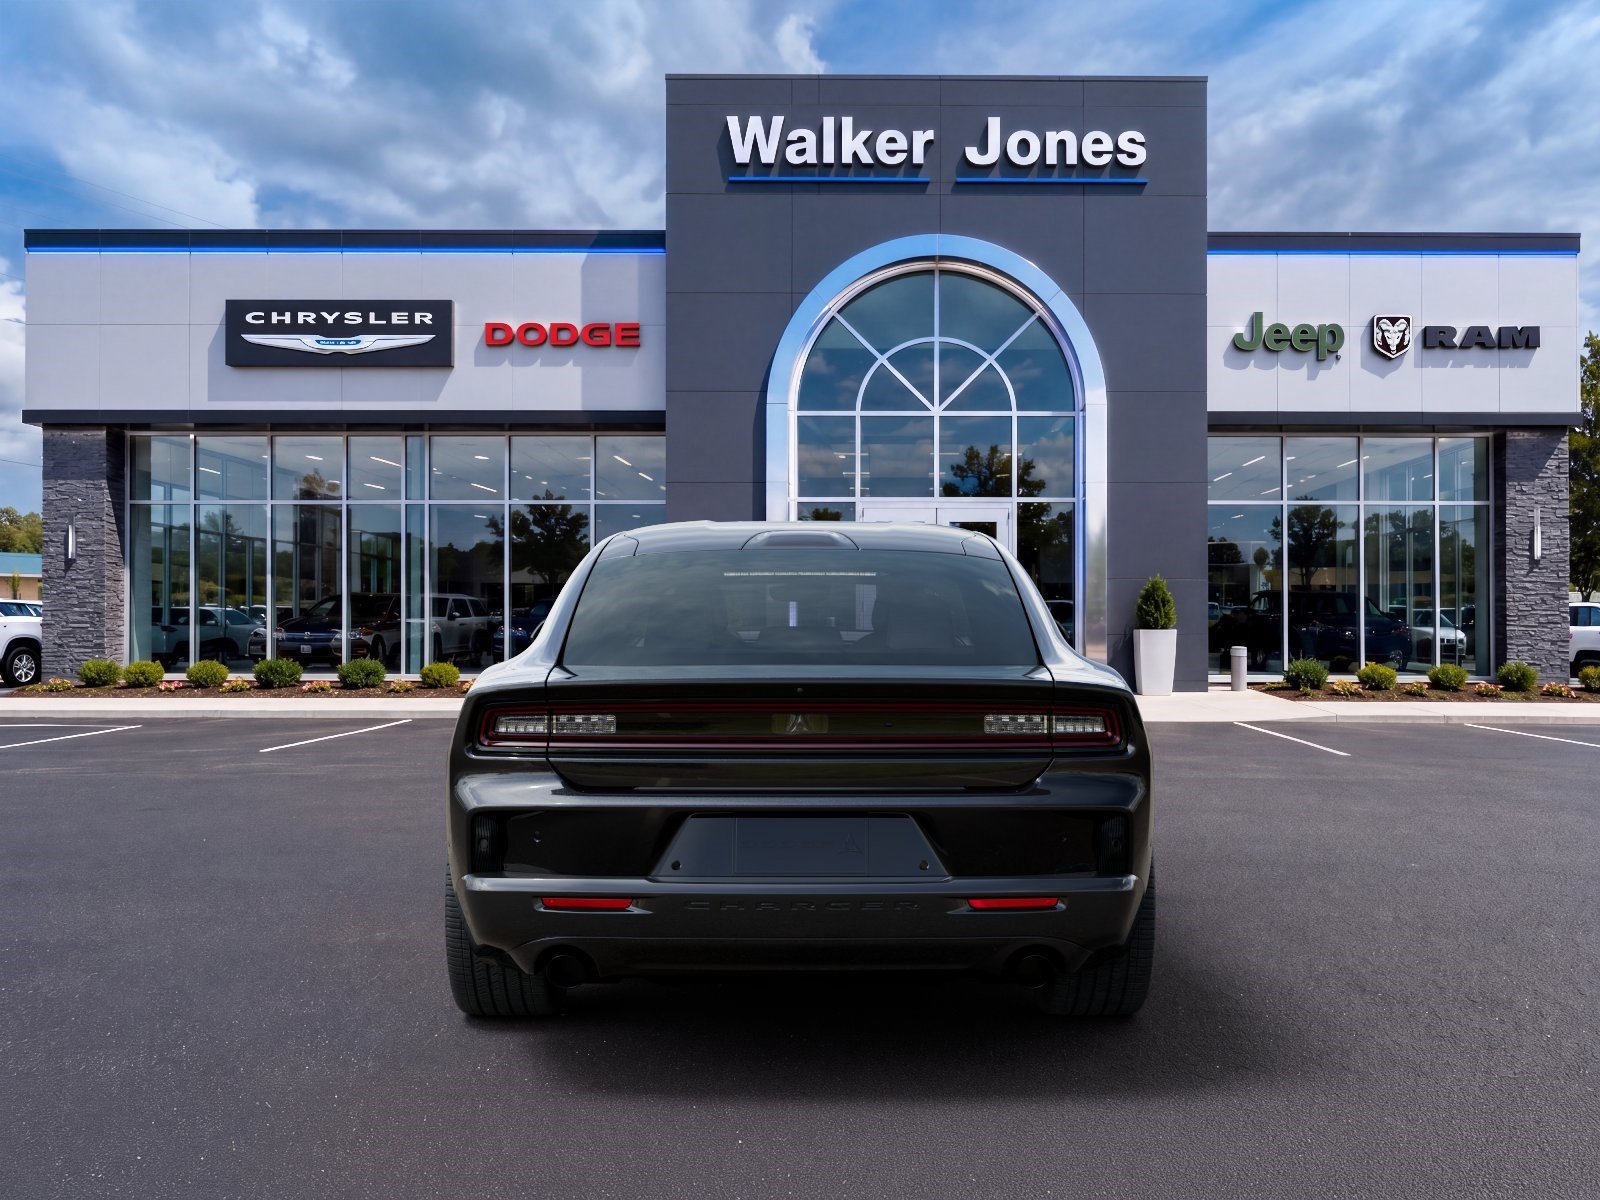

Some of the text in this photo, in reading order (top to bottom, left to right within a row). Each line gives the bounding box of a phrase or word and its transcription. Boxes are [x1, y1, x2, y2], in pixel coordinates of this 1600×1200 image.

[726, 115, 1148, 166] Walker Jones
[245, 311, 433, 325] CHRYSLER
[485, 322, 640, 347] DODGE
[1233, 311, 1345, 360] Jeep
[1423, 325, 1541, 348] RAM
